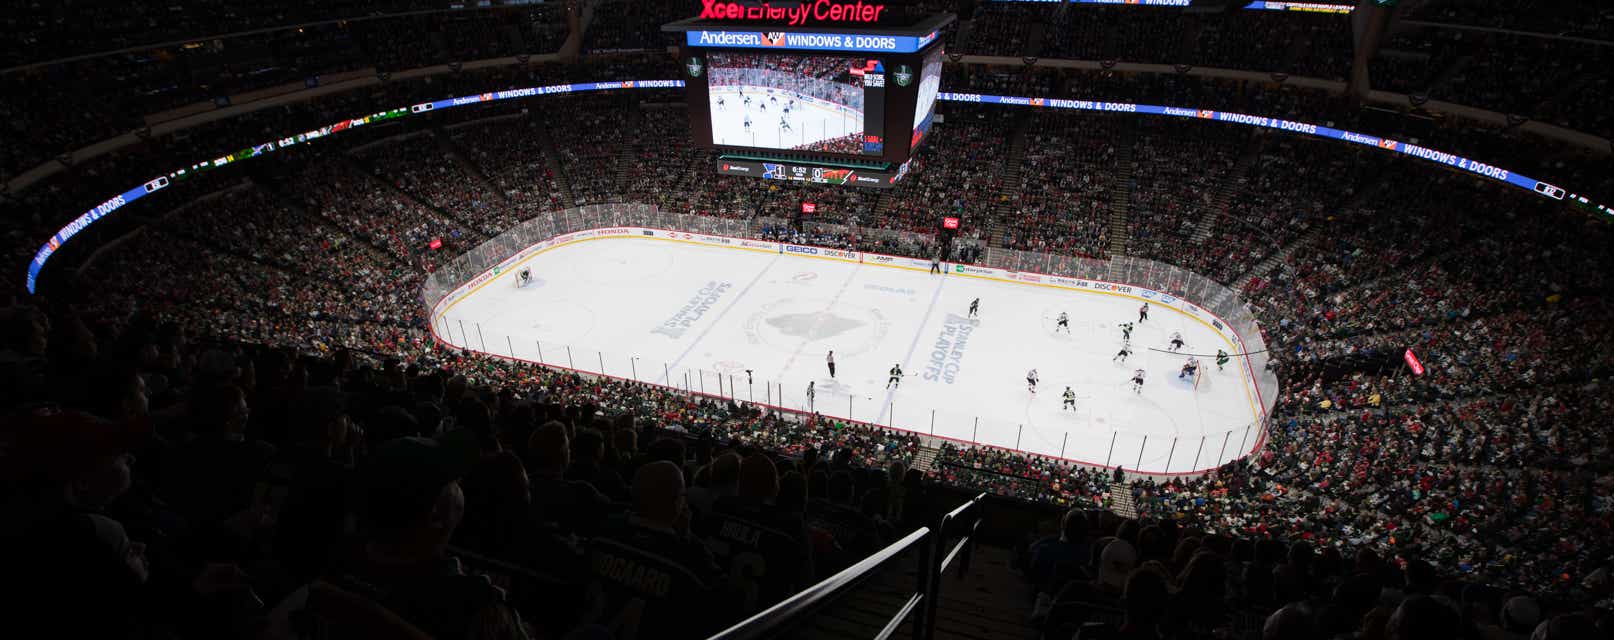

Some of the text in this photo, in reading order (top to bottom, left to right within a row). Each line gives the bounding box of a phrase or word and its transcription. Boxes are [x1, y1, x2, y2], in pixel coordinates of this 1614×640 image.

[814, 0, 885, 22] Center
[700, 31, 760, 45] Andersen
[788, 35, 841, 47] WINDOWS
[844, 37, 853, 47] &
[856, 37, 896, 49] DOORS
[498, 88, 535, 99] WINDOWS
[546, 85, 572, 94] DOORS
[638, 80, 674, 88] WINDOWS
[953, 93, 981, 102] DOORS
[1000, 96, 1136, 112] Andersen WINDOWS & DOORS
[1163, 107, 1317, 134] Andersen WINDOWS & DOORS
[1341, 131, 1508, 180] Andersen WINDOWS & DOORS
[58, 212, 92, 241] WINDOWS
[97, 195, 126, 216] DOORS
[786, 245, 817, 255] GEICO
[824, 249, 856, 259] DISCOVER
[1094, 283, 1132, 294] DISCOVER
[680, 280, 732, 327] PLAYOFFS
[950, 324, 973, 363] STANLEY
[922, 324, 956, 382] PLAYOFFS
